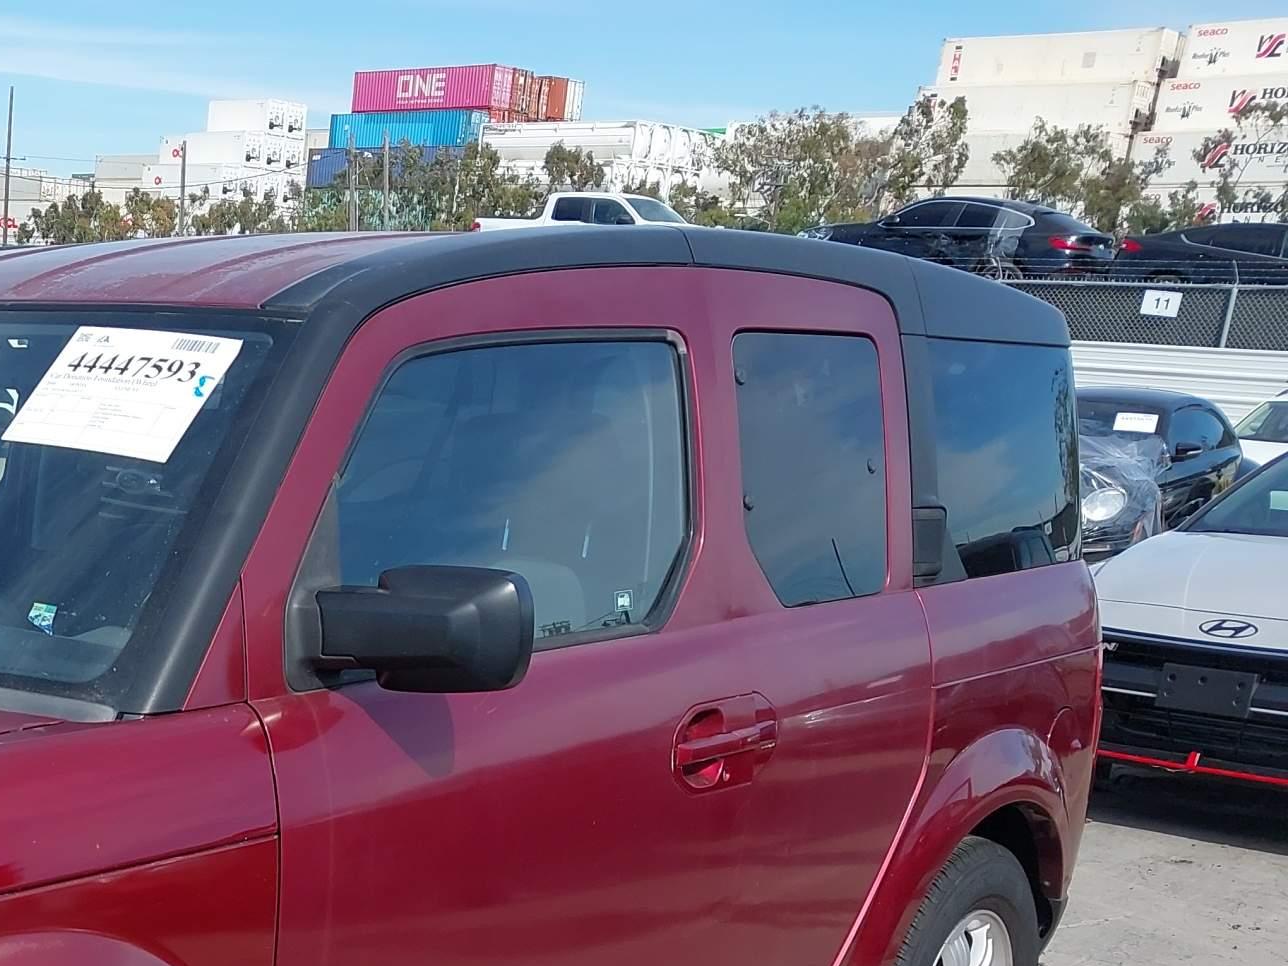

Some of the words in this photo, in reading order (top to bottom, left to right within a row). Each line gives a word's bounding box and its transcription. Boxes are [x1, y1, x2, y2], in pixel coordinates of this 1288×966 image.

[1197, 28, 1229, 37] seaco
[396, 73, 446, 97] ONE
[1169, 82, 1201, 91] seaco
[1142, 136, 1173, 144] seaco
[1155, 297, 1171, 310] 11
[68, 352, 201, 382] 44447593
